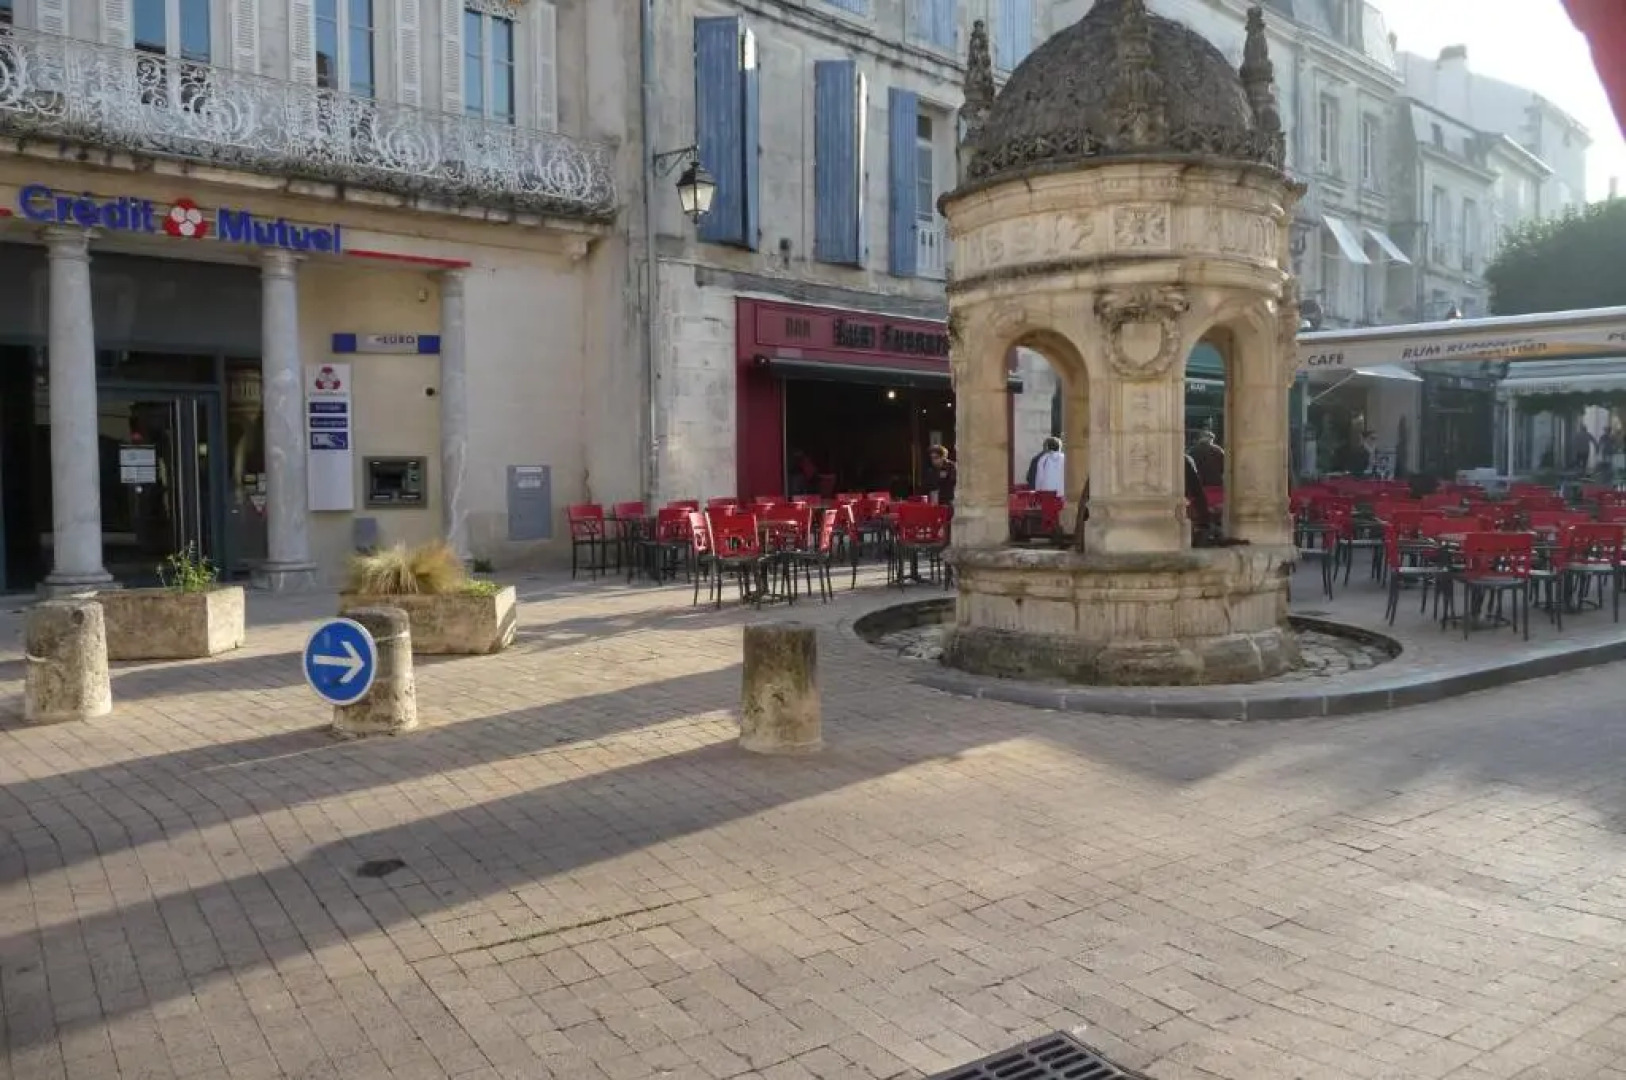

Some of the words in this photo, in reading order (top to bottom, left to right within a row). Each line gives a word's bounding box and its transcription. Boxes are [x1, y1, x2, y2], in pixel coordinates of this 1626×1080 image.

[18, 183, 156, 231] Crédit
[215, 207, 341, 254] Mutuel
[1402, 344, 1441, 359] RUM
